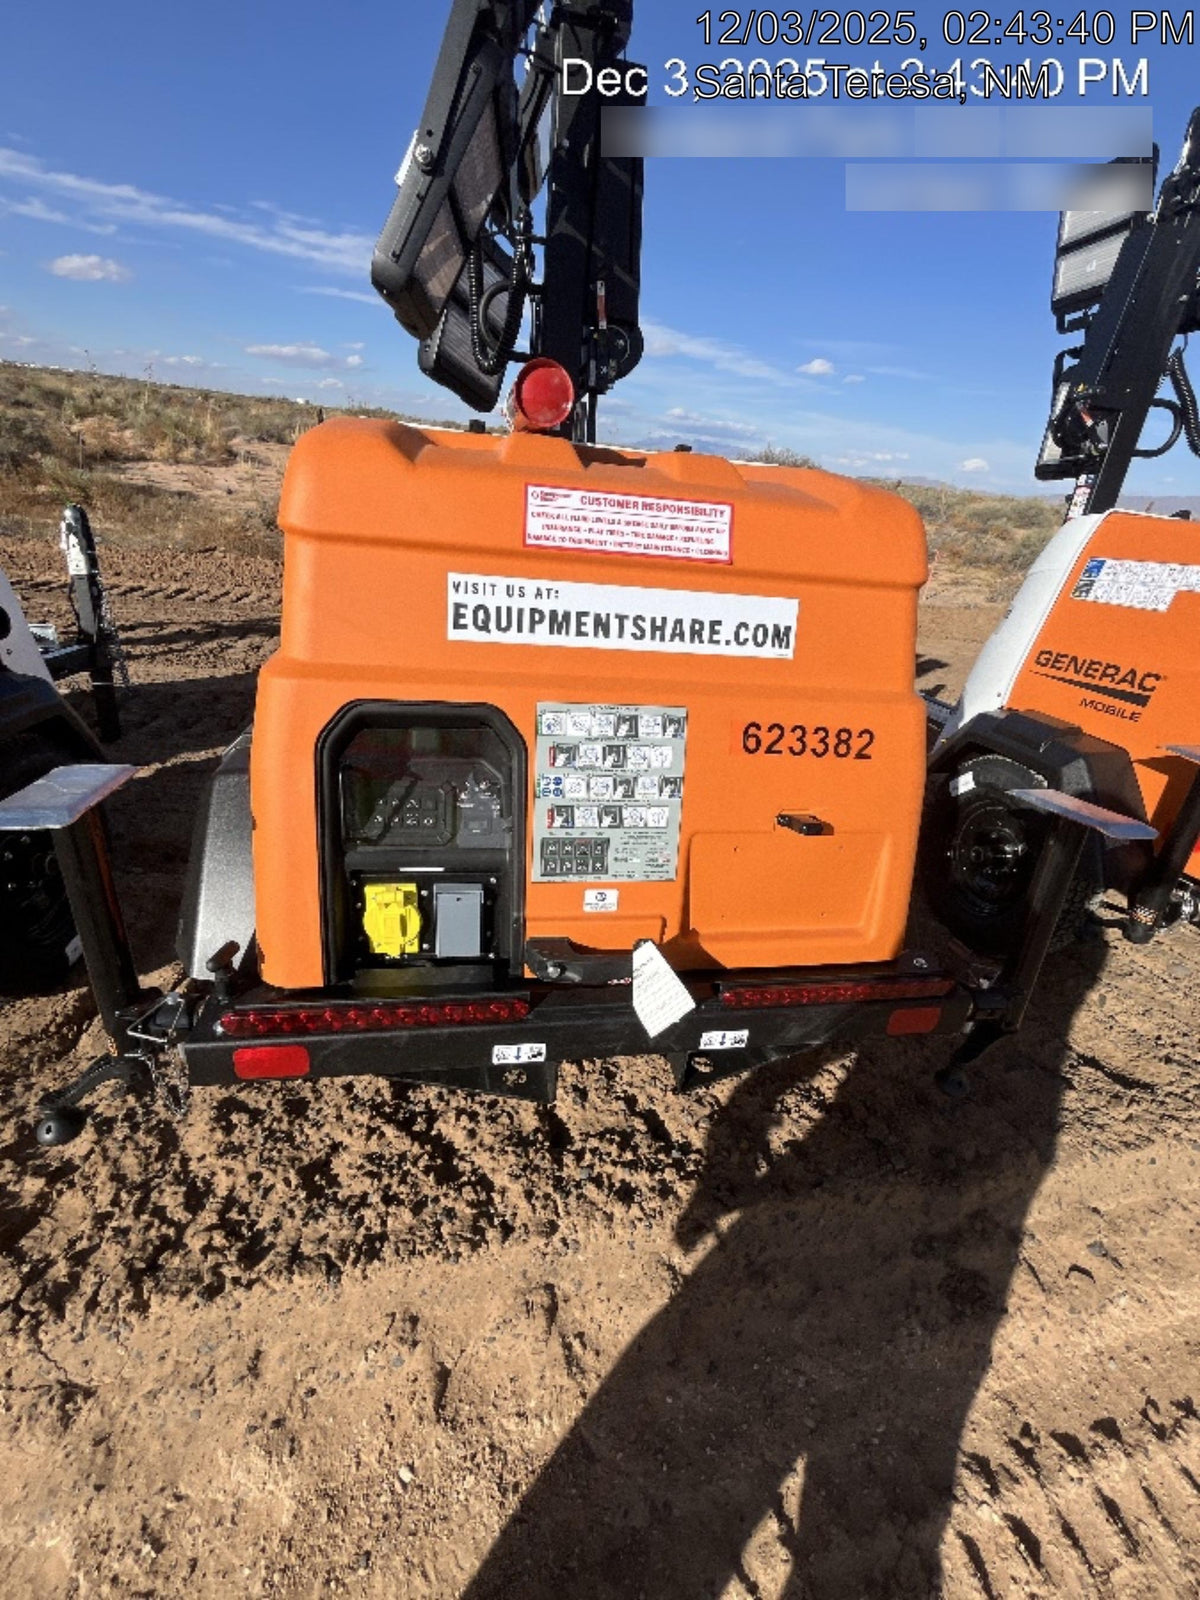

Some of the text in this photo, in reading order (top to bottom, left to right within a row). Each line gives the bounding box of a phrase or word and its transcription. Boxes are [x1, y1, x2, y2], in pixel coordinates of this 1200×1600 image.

[580, 495, 639, 510] CUSTOMER
[641, 500, 725, 518] RESPONSIBILITY
[452, 581, 560, 600] VISIT US AT:
[452, 602, 792, 650] EQUIPMENTSHARE.COM
[1034, 650, 1162, 692] GENERAC
[1079, 697, 1142, 722] MOBILE
[742, 721, 875, 759] 623382
